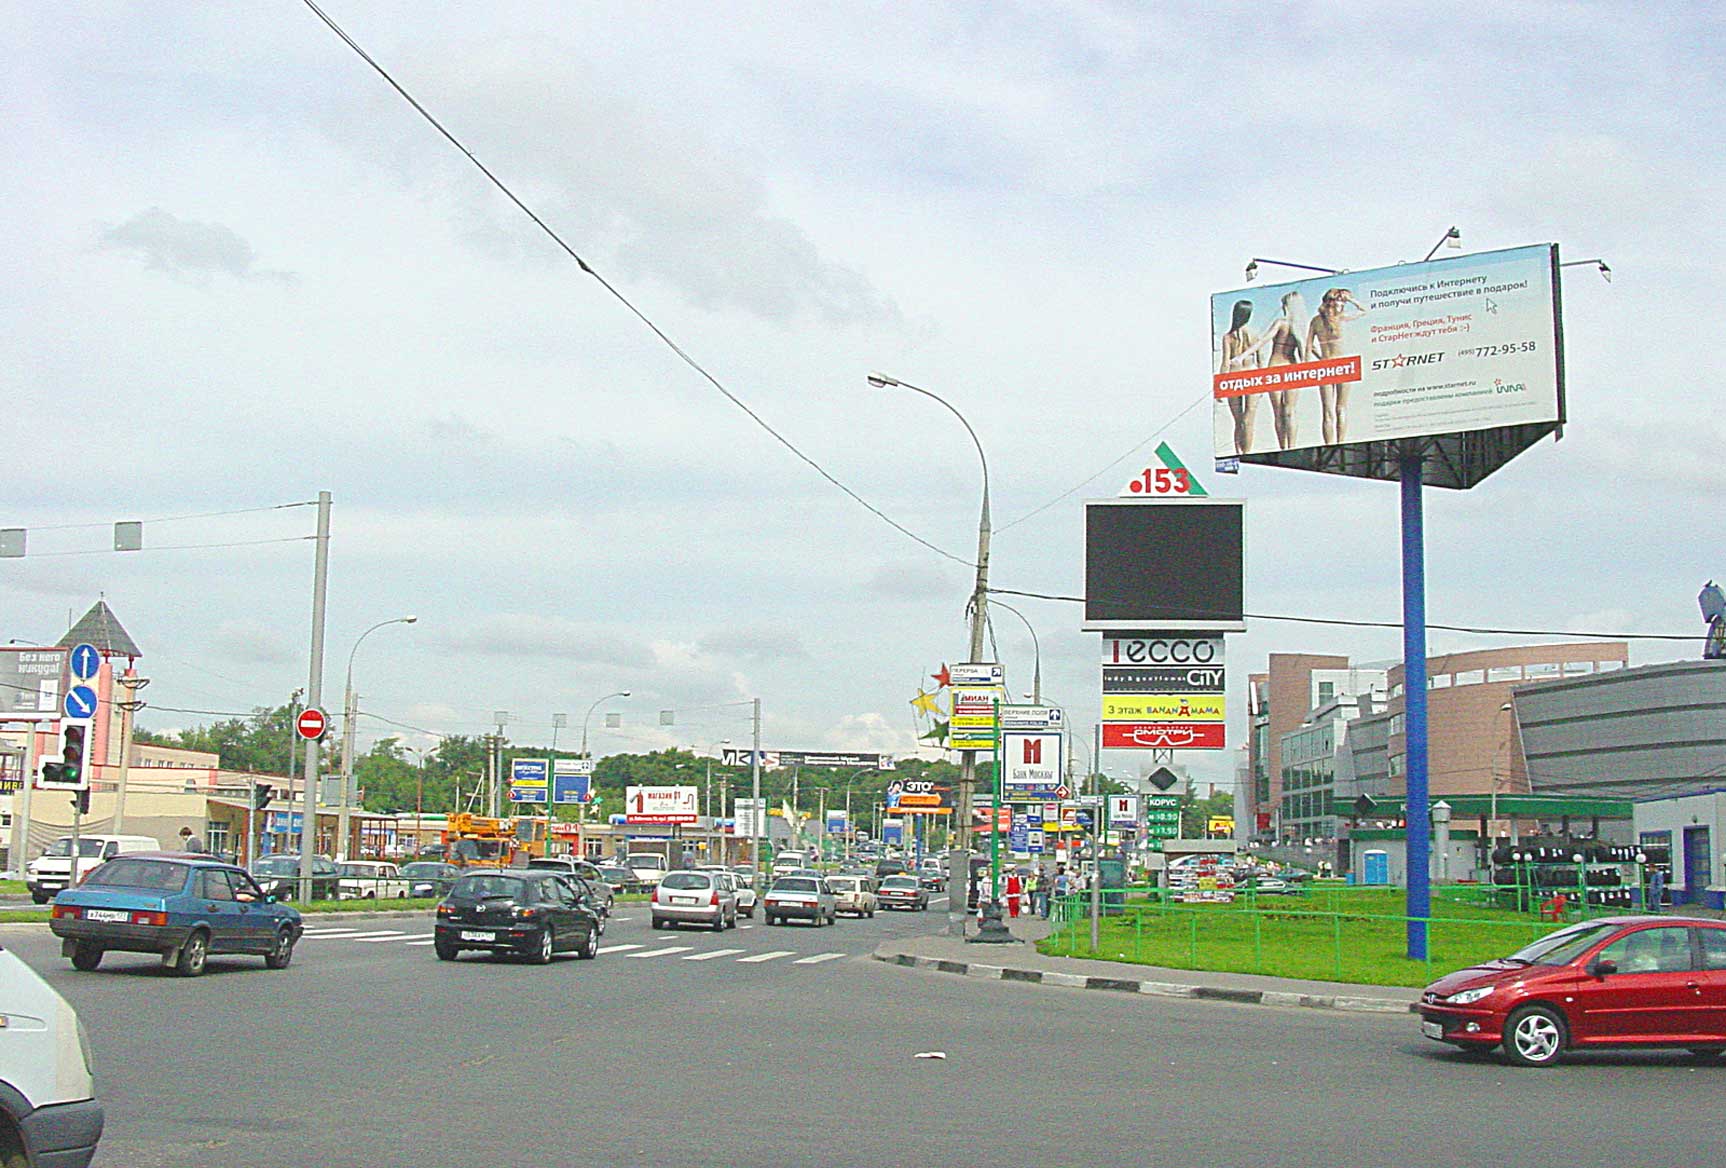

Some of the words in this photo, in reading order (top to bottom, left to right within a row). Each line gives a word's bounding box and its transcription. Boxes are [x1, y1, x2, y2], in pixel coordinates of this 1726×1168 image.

[1370, 284, 1428, 298] Подключись
[1436, 274, 1488, 288] Интернету
[1378, 298, 1412, 309] получи
[1413, 290, 1474, 305] путешествие
[1483, 280, 1528, 293] подарок!
[1446, 313, 1472, 325] Тунис
[1438, 326, 1458, 335] тебя
[1475, 341, 1536, 358] 772-95-58
[1219, 376, 1263, 391] отдых
[1265, 373, 1281, 384] за
[1283, 361, 1356, 383] интернет!
[1126, 640, 1215, 663] ecco
[1108, 705, 1115, 714] 3
[1117, 706, 1142, 714] этаж
[906, 781, 932, 792] ЭТО
